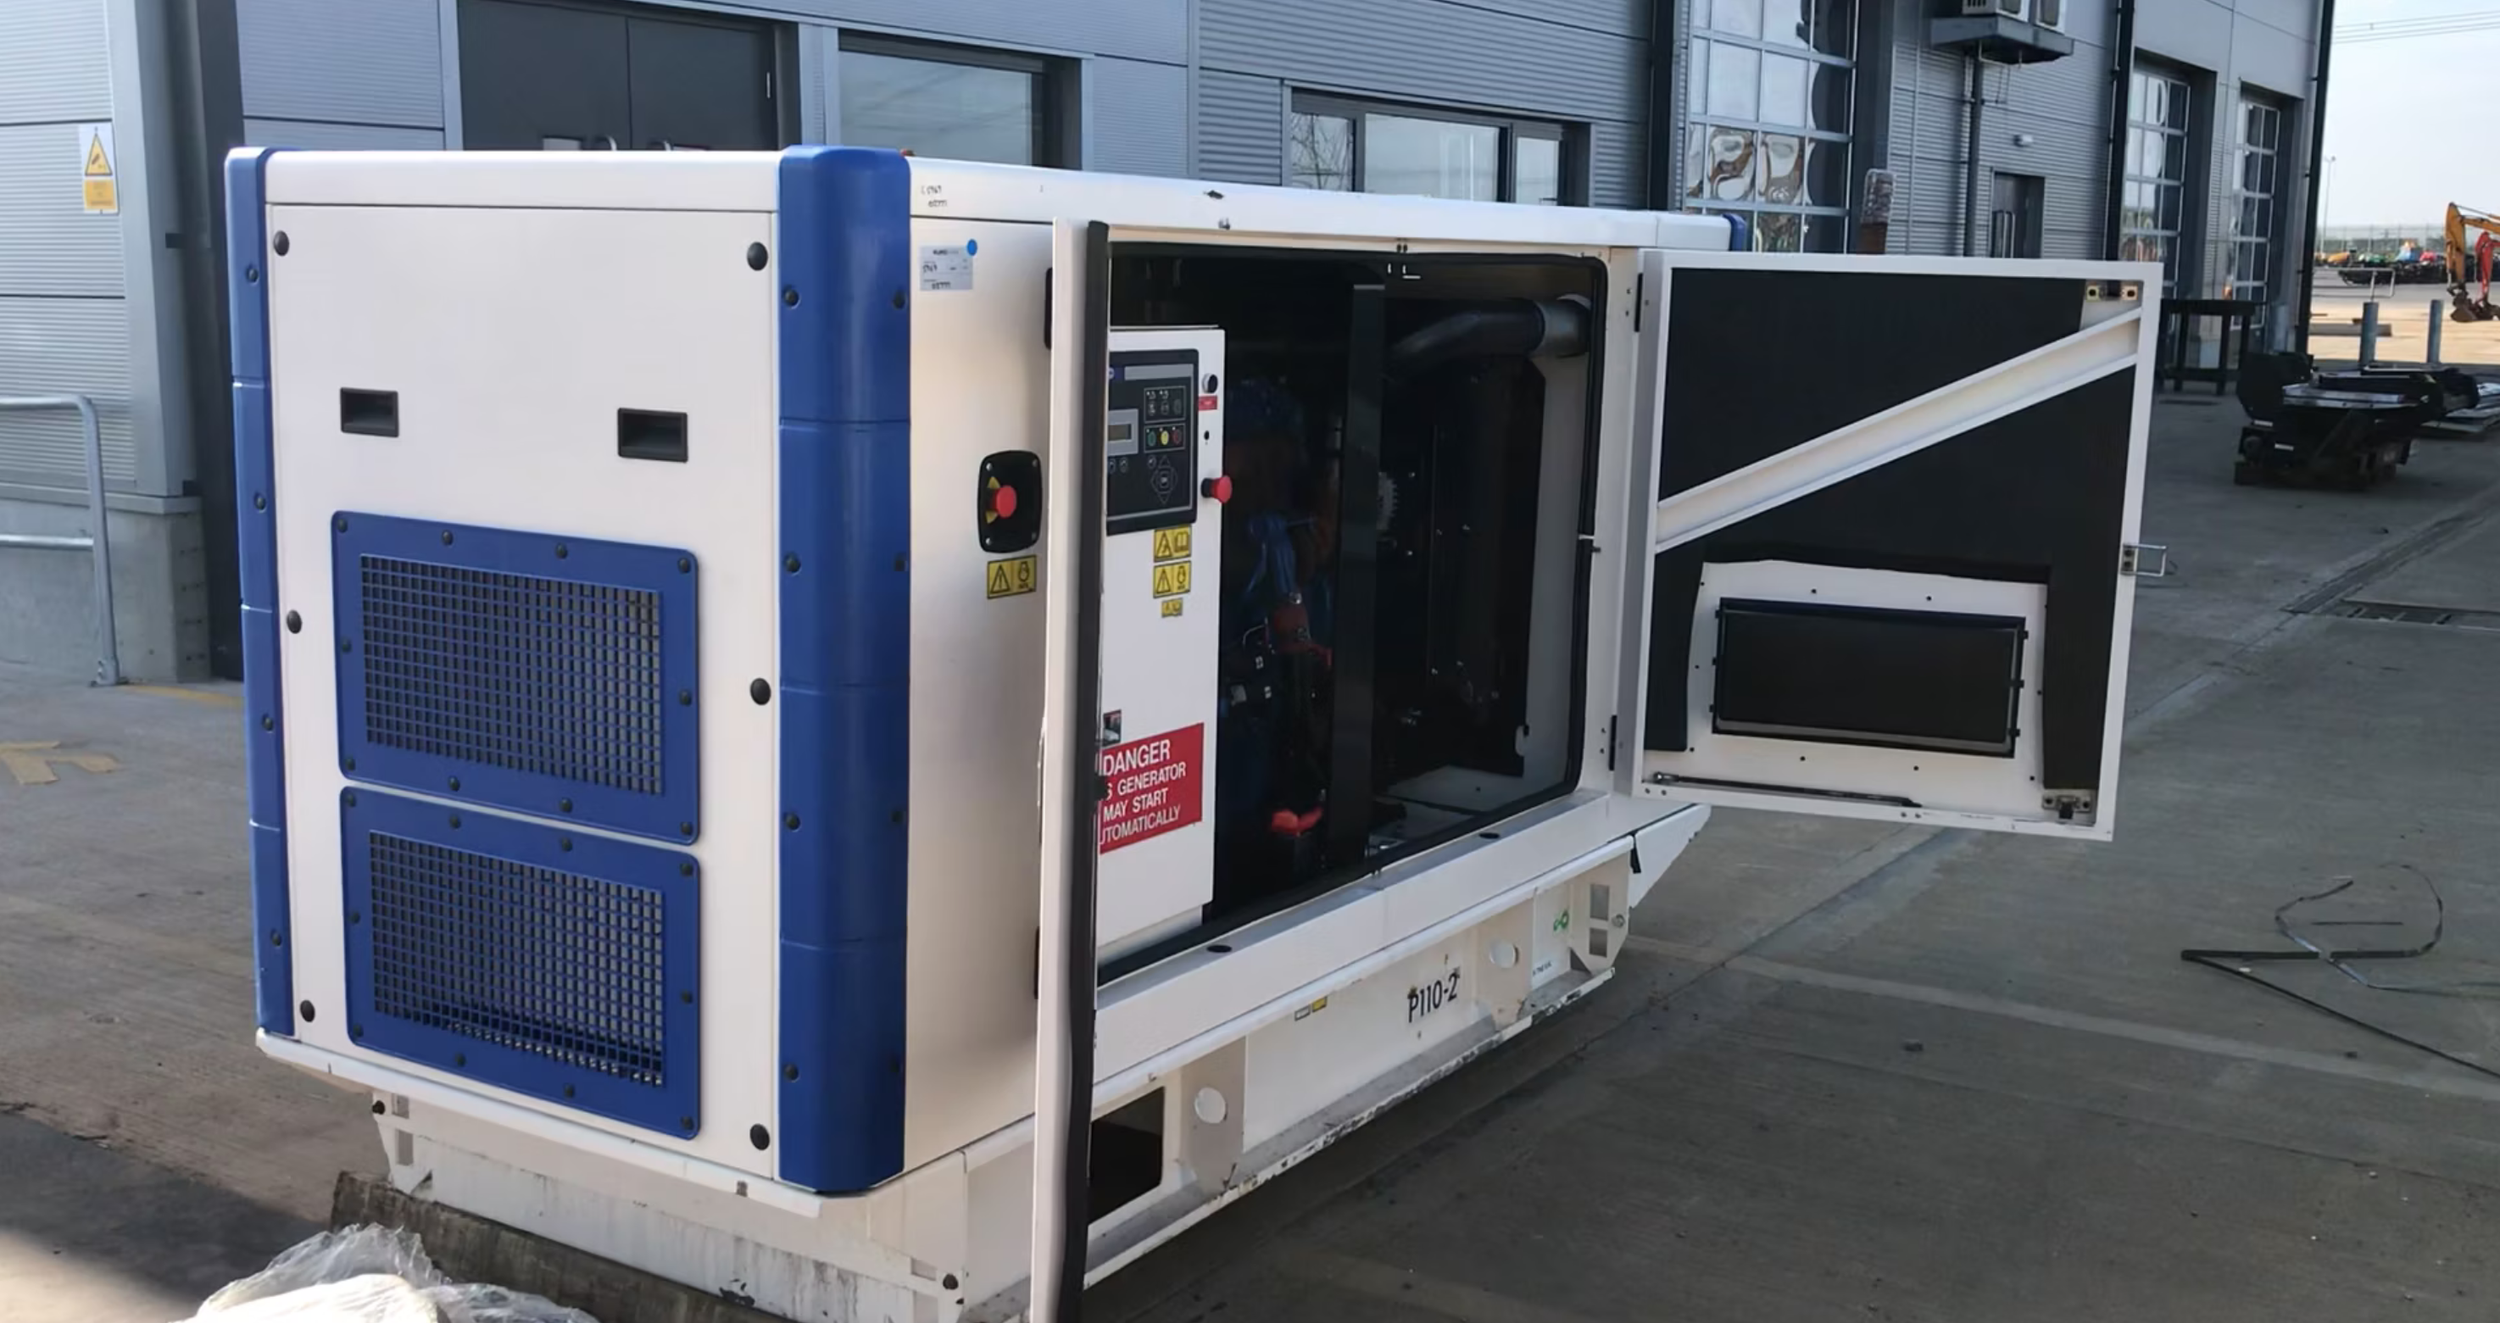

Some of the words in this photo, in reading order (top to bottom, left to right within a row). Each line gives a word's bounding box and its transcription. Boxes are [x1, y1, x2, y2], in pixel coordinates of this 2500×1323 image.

[1103, 739, 1171, 776] DANGER
[1117, 761, 1187, 796] GENERATOR
[1103, 800, 1128, 822] MAY
[1132, 788, 1168, 812] START
[1099, 805, 1181, 845] UTOMATICALLY
[1408, 970, 1460, 1023] P110-2
